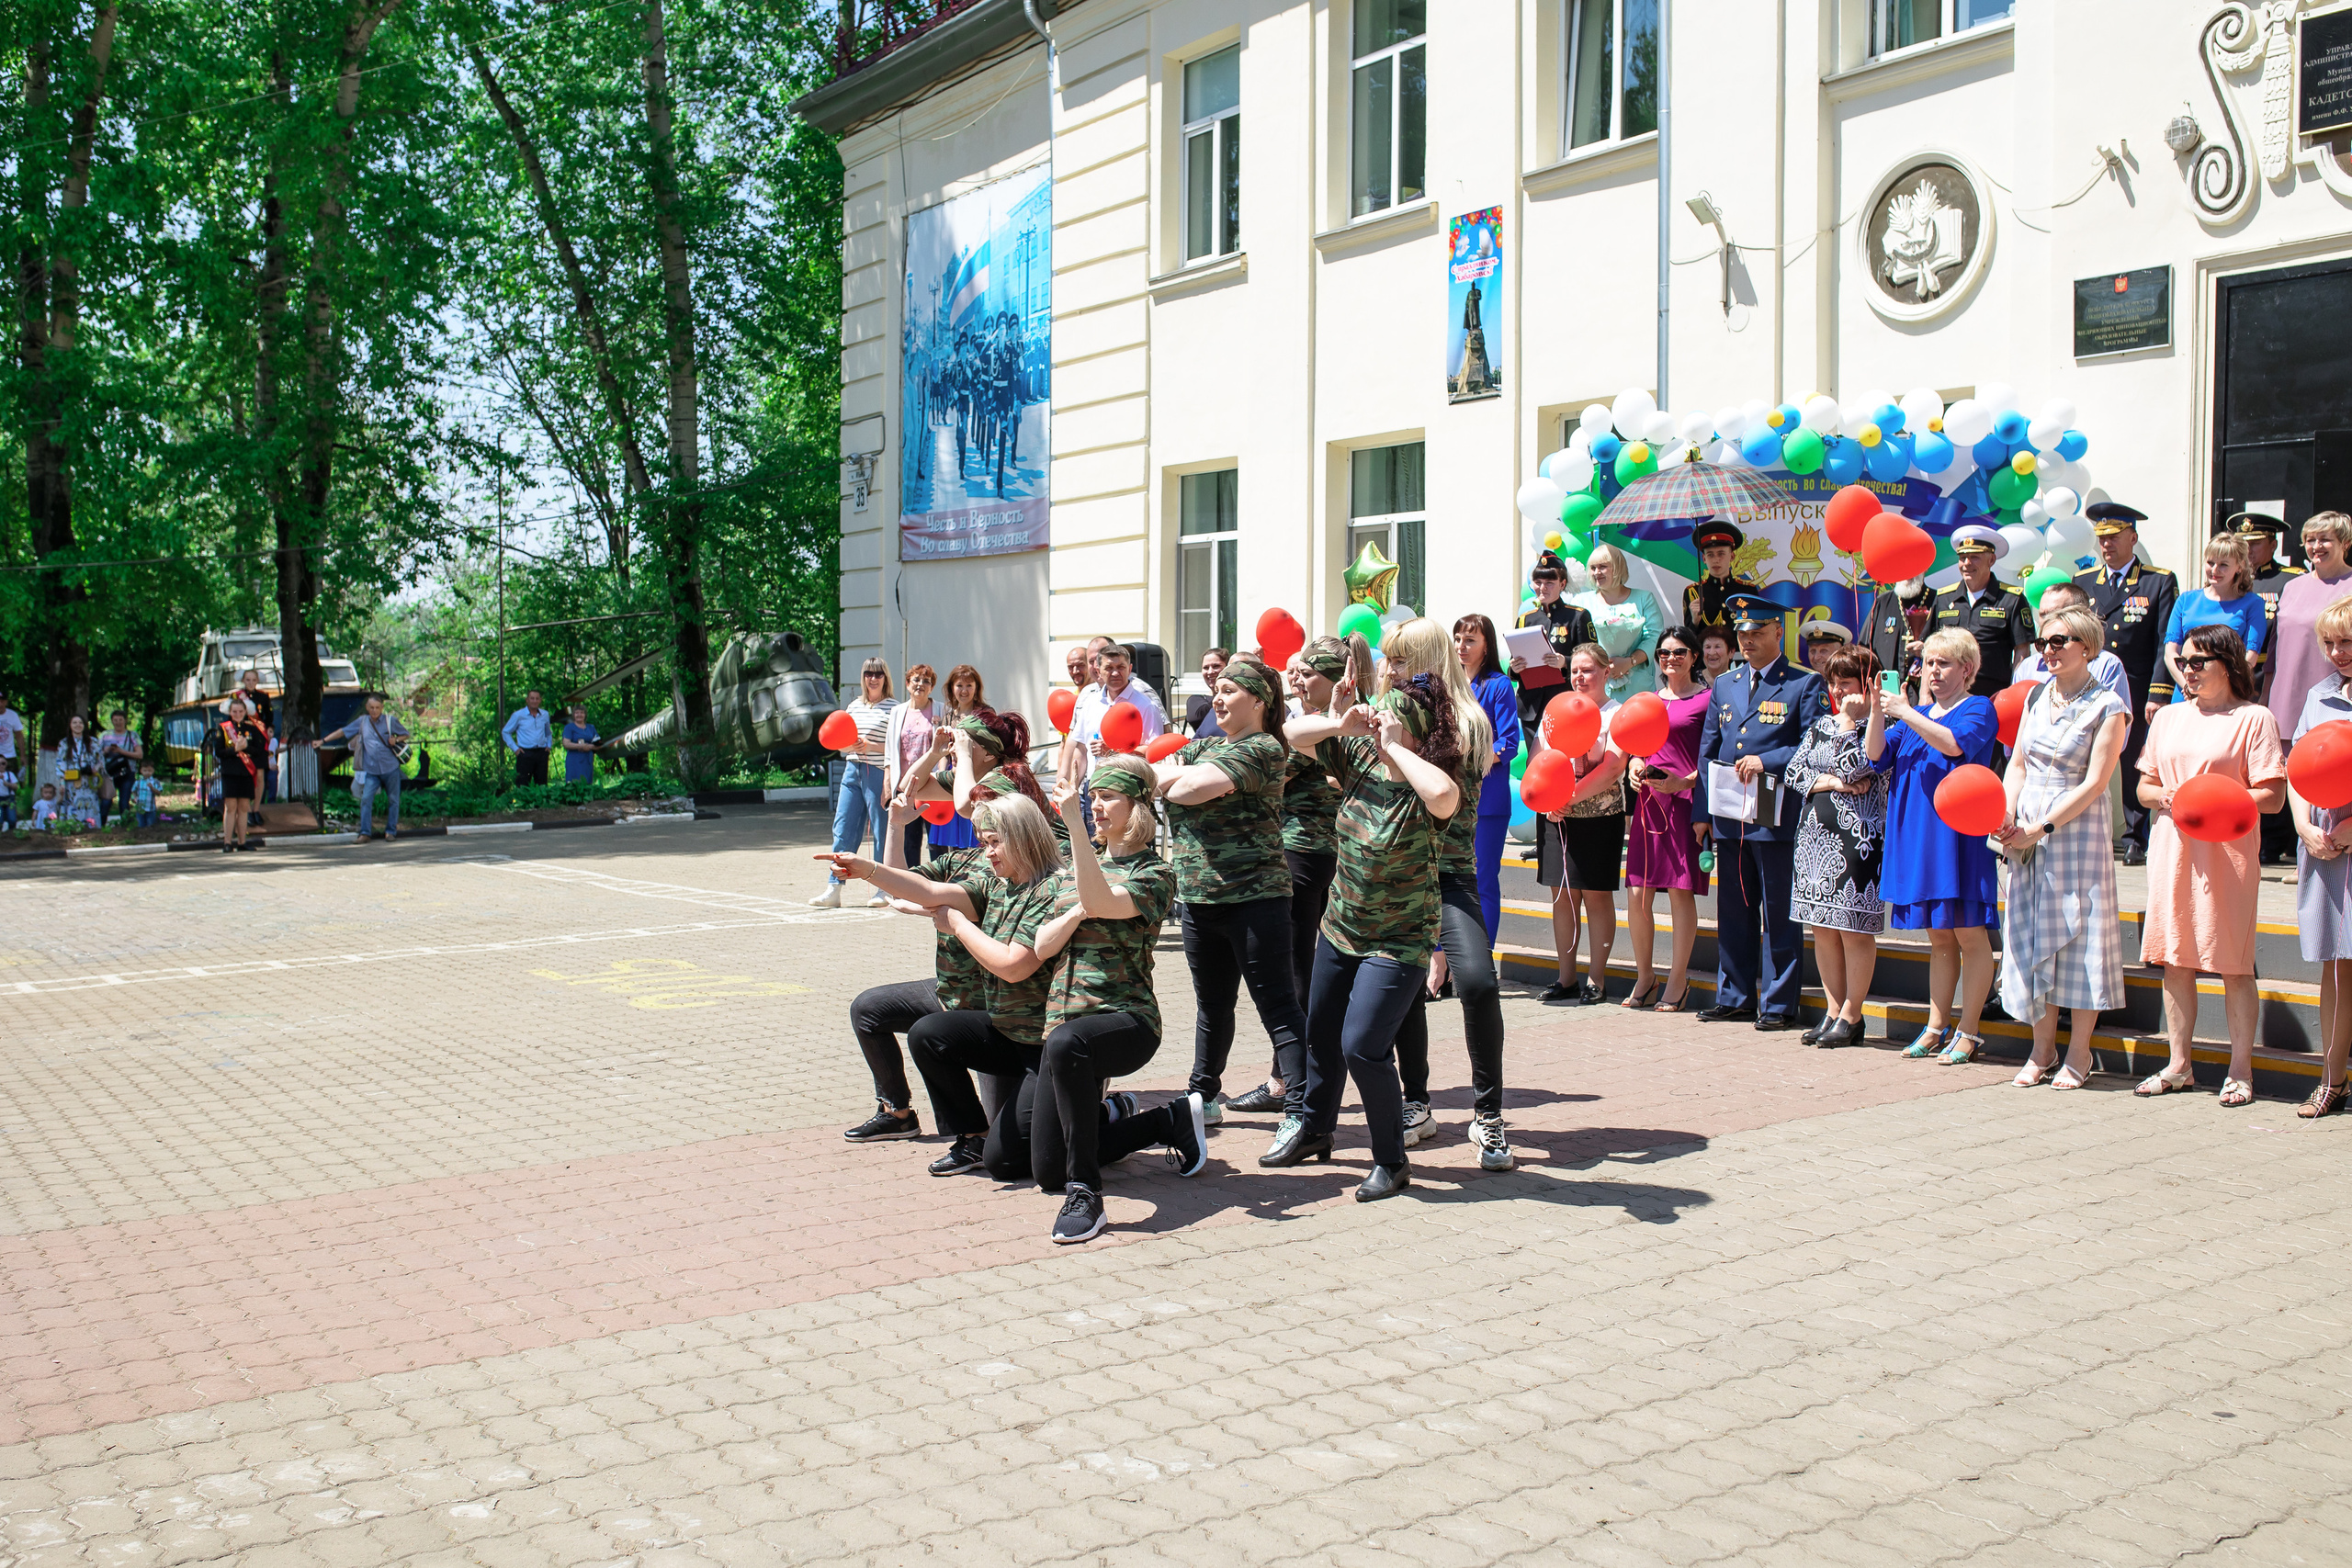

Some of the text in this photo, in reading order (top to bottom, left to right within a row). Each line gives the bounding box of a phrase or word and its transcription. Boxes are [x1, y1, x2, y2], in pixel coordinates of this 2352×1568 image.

[2318, 74, 2352, 85] общеобра
[1804, 479, 1815, 491] во
[855, 486, 865, 507] 35
[926, 508, 1024, 533] Честь и Верность
[921, 530, 1029, 555] Во славу Отечества
